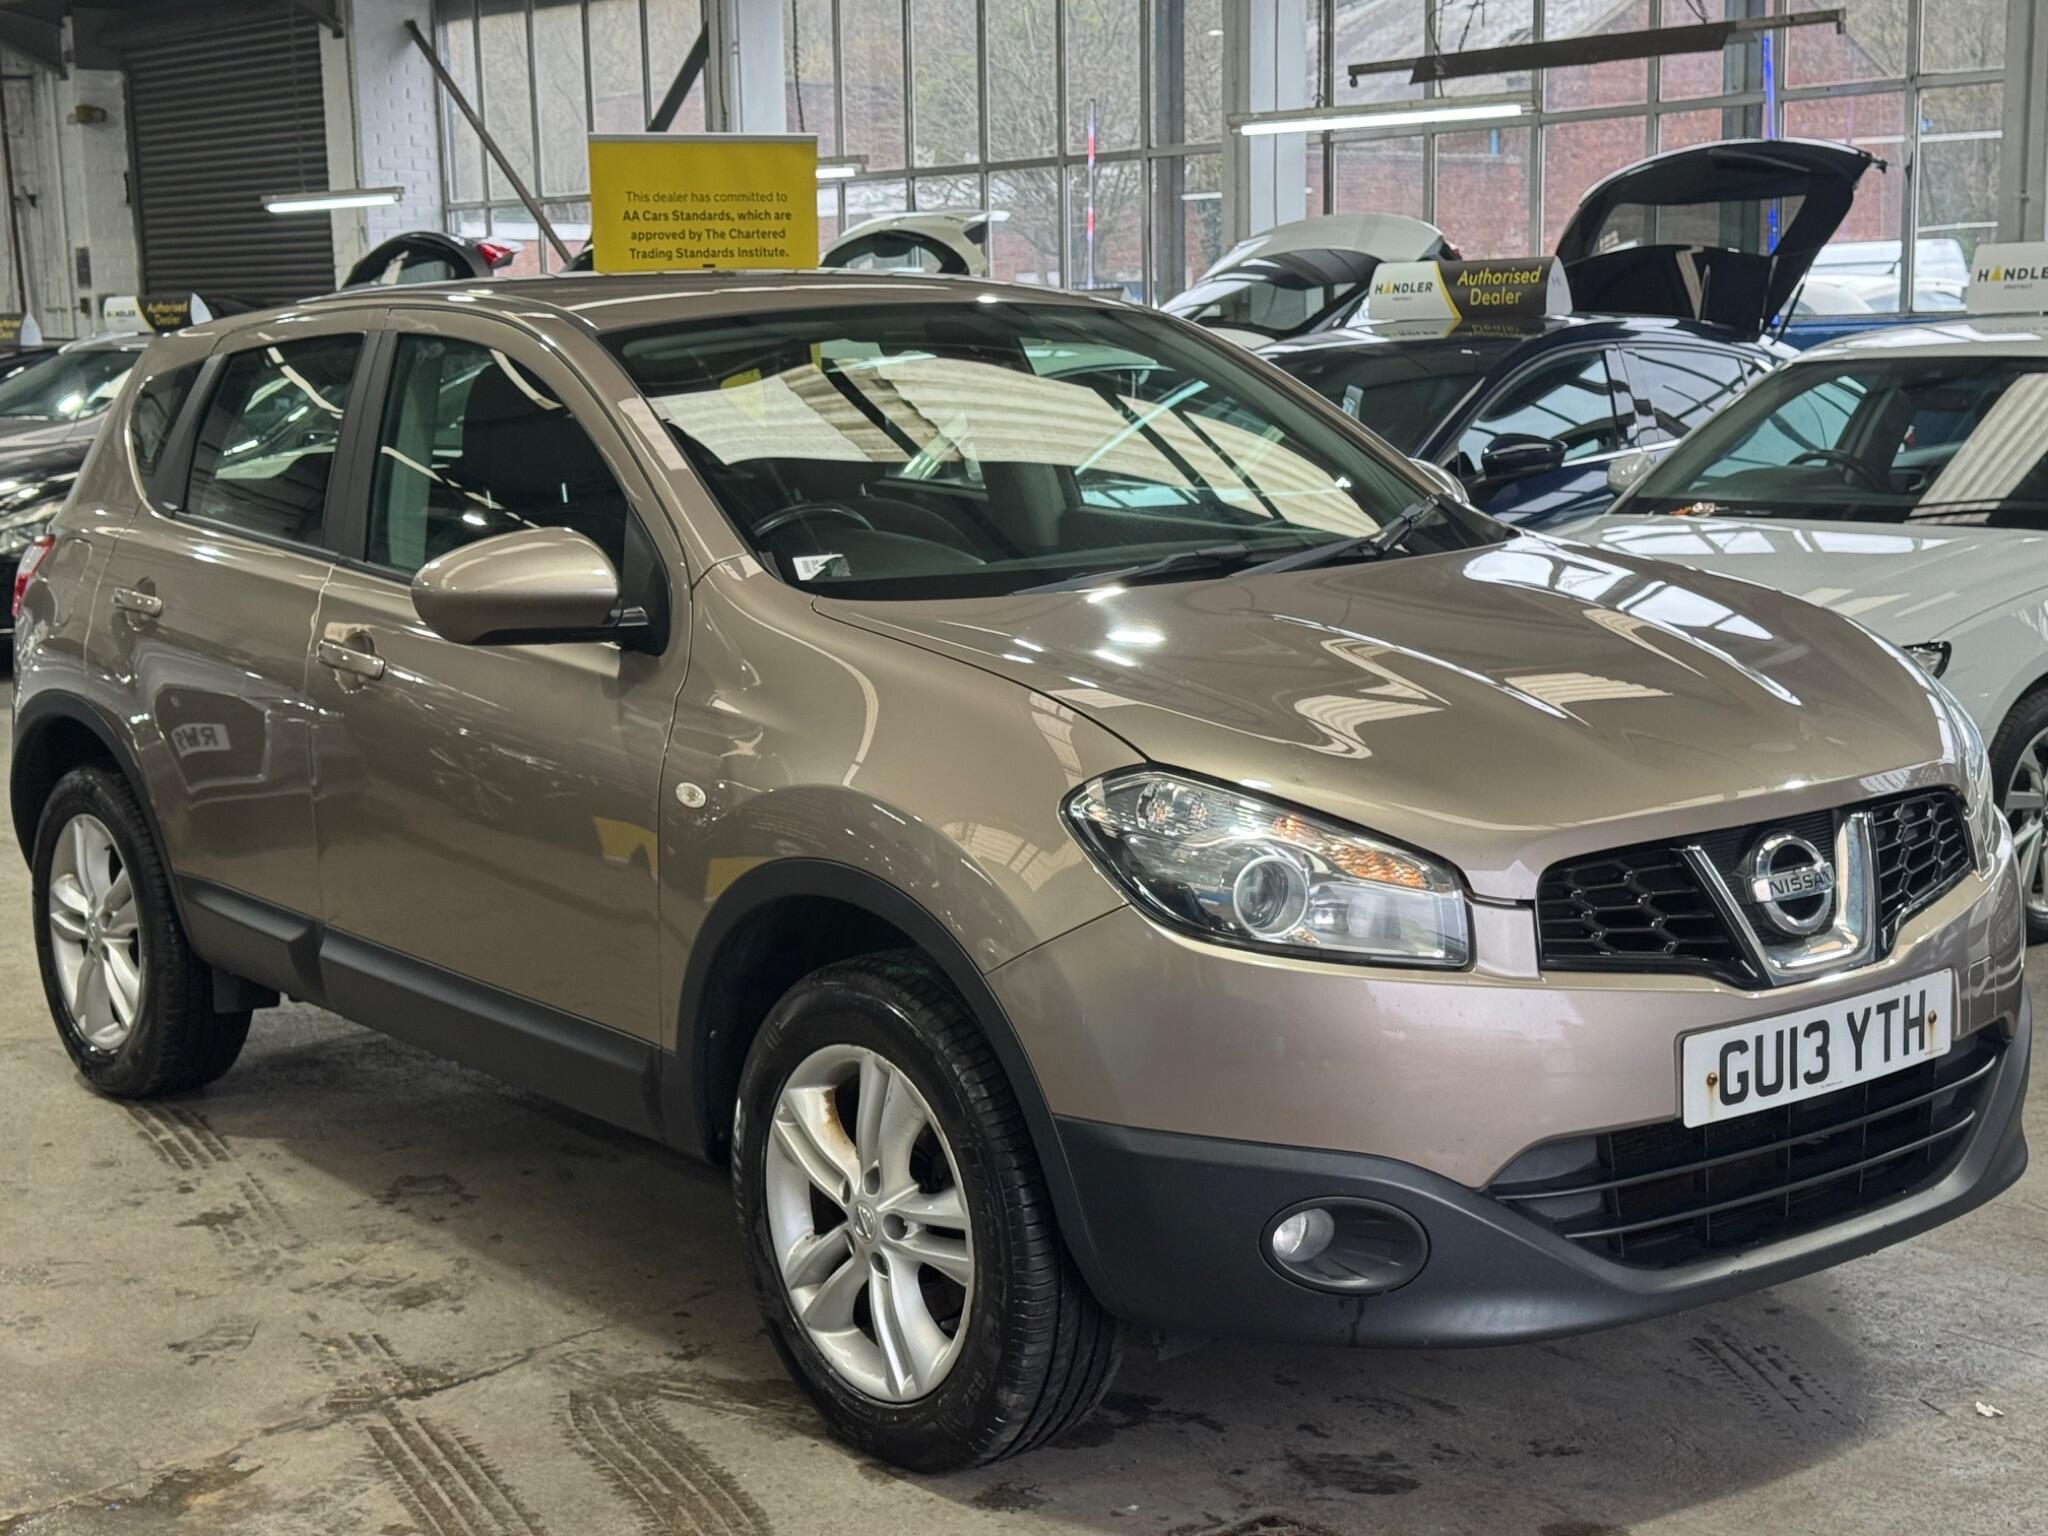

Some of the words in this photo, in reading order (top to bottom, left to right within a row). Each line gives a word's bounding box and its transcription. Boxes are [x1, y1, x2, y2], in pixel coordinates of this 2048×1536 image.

[625, 190, 650, 203] This
[652, 191, 688, 203] dealer
[690, 191, 711, 203] has
[713, 191, 773, 203] committed
[776, 191, 788, 202] to
[622, 210, 640, 221] AA
[642, 209, 669, 221] Cars
[671, 209, 735, 222] Standards,
[737, 209, 772, 221] which
[774, 211, 792, 220] are
[630, 229, 686, 243] approved
[688, 228, 702, 242] by
[704, 228, 726, 240] The
[728, 227, 786, 240] Chartered
[629, 248, 673, 261] Trading
[675, 247, 735, 259] Standards
[737, 246, 789, 258] Institute.
[1456, 264, 1542, 287] Authorised
[1469, 286, 1522, 306] Dealer
[1769, 869, 1832, 896] NISSAN
[1719, 1019, 1830, 1106] GU13
[1847, 989, 1926, 1072] YTH
